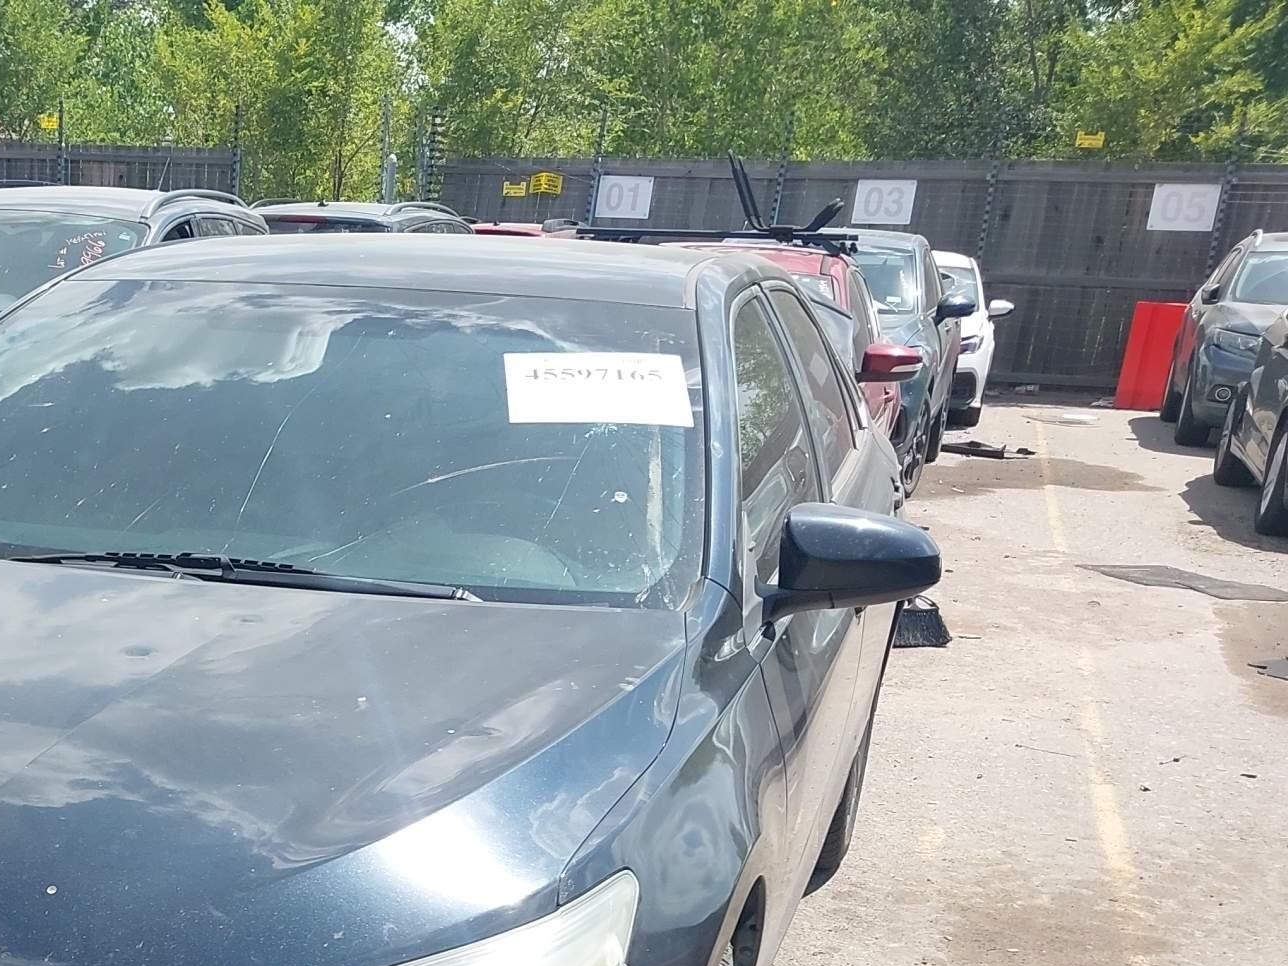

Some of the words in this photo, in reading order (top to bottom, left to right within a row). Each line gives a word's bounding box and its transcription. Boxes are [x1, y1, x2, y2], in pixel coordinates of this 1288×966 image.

[605, 182, 640, 211] 01
[864, 186, 904, 217] 03
[1161, 191, 1207, 222] 05
[524, 367, 663, 382] 45597165
